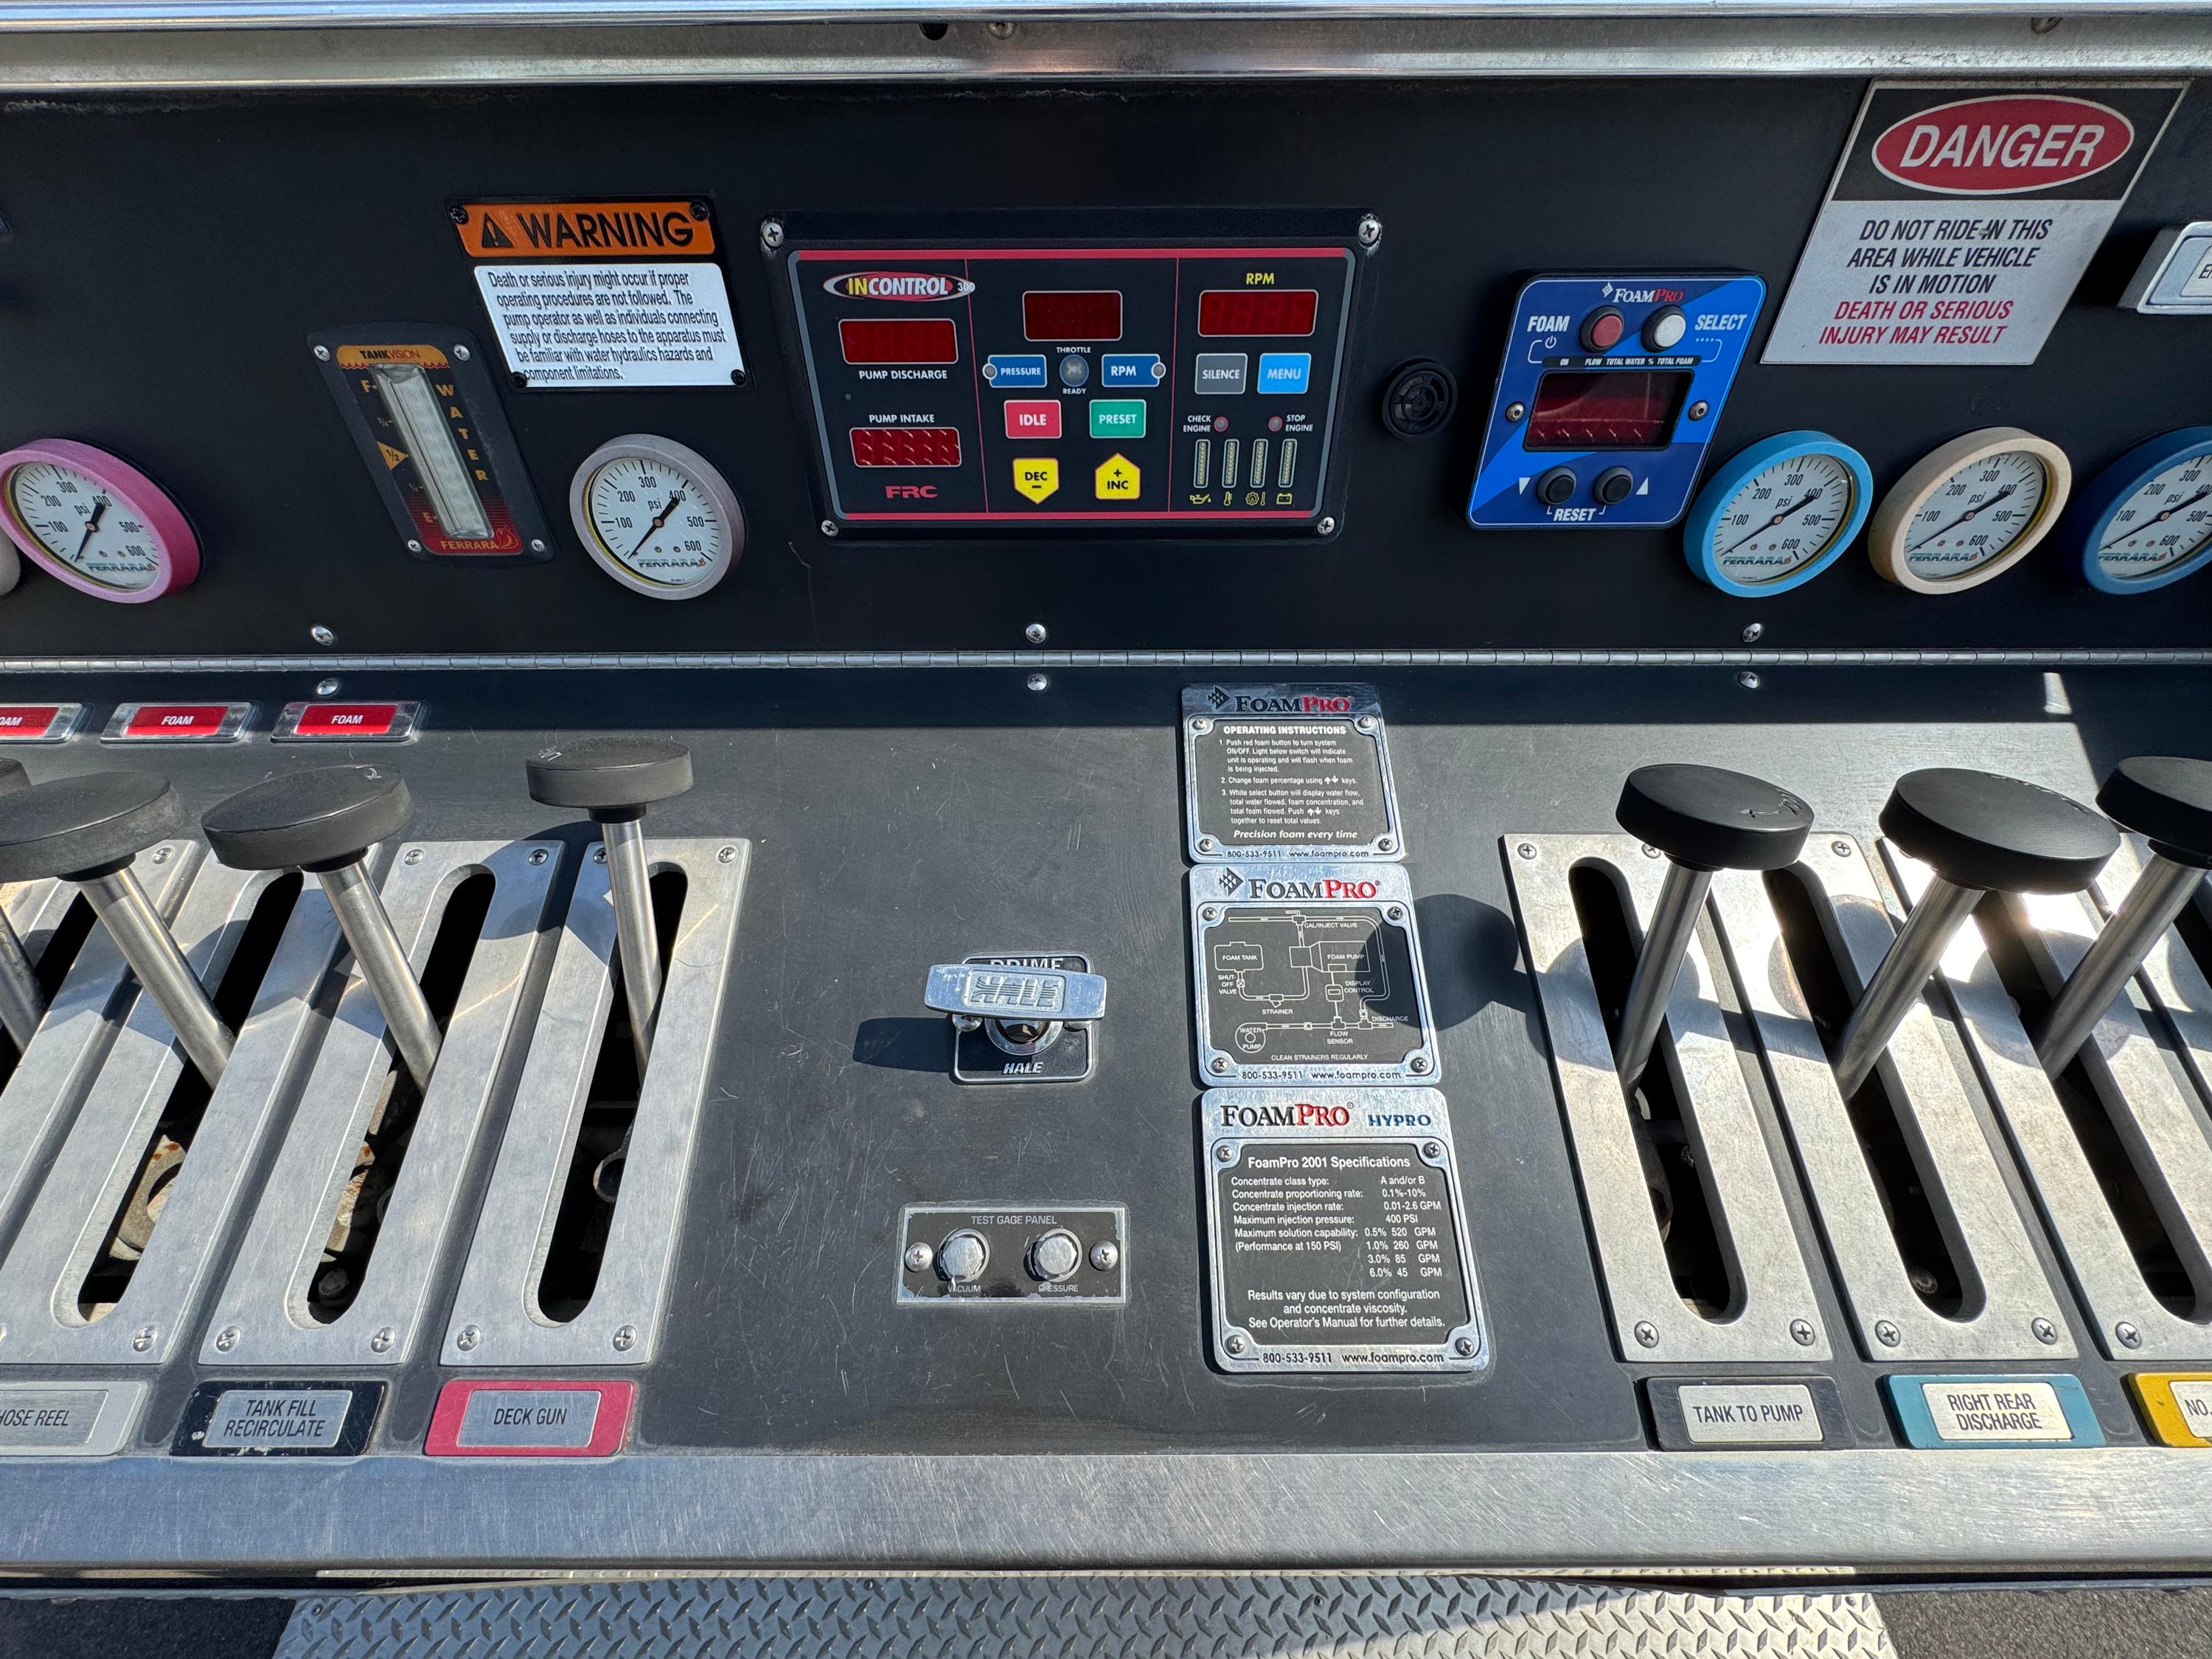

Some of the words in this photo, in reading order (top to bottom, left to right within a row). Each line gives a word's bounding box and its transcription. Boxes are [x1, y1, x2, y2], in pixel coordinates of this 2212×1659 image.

[1899, 124, 2106, 168] DANGER
[518, 212, 694, 248] WARNING
[1859, 219, 1889, 240] DO
[1892, 219, 1935, 240] NOT
[1933, 219, 1983, 240] RIDE
[1980, 219, 2007, 240] IN
[2007, 219, 2053, 240] THIS
[1846, 248, 1896, 268] AREA
[1902, 248, 1962, 268] WHILE
[1963, 247, 2041, 268] VEHICLE
[488, 271, 518, 288] Death
[520, 275, 529, 287] or
[532, 272, 566, 287] serious
[567, 271, 591, 291] injury
[594, 271, 622, 291] might
[622, 274, 647, 286] occur
[648, 271, 658, 286] if
[658, 273, 689, 291] proper
[1246, 273, 1275, 285] RPM
[1869, 274, 1888, 293] IS
[1892, 274, 1915, 293] IN
[1918, 274, 1997, 293] MOTION
[848, 277, 949, 296] INCONTROL
[957, 282, 975, 292] 300
[497, 291, 542, 310] operating
[543, 291, 594, 309] procedures
[596, 293, 611, 305] are
[612, 291, 627, 305] not
[628, 290, 672, 305] followed.
[674, 290, 693, 305] The
[1834, 301, 1896, 320] DEATH
[1902, 301, 1926, 319] OR
[1930, 301, 2014, 319] SERIOUS
[1528, 316, 1571, 333] FOAM
[1695, 314, 1747, 330] SELECT
[1819, 326, 1888, 344] INJURY
[1890, 326, 1932, 344] MAY
[1933, 326, 2008, 344] RESULT
[1559, 358, 1569, 366] ON
[1585, 358, 1602, 366] FLOW
[1606, 358, 1624, 366] TOTAL
[1625, 358, 1645, 366] WATER
[1647, 358, 1654, 366] %
[1657, 358, 1674, 366] TOTAL
[524, 368, 574, 383] component
[574, 366, 624, 380] limitations.
[859, 370, 888, 380] PUMP
[891, 370, 948, 380] DISCHARGE
[1001, 367, 1041, 376] PRESSURE
[1110, 366, 1137, 377] RPM
[1202, 369, 1240, 380] SILENCE
[1267, 369, 1301, 380] MENU
[869, 414, 898, 423] PUMP
[900, 414, 935, 423] INTAKE
[1019, 414, 1047, 425] IDLE
[1099, 414, 1137, 425] PRESET
[1187, 415, 1211, 423] CHECK
[1287, 414, 1306, 422] STOP
[1285, 424, 1313, 432] ENGINE
[639, 476, 657, 488] 300
[1024, 471, 1048, 481] DEC
[1784, 474, 1804, 486] 300
[1107, 481, 1129, 490] INC
[617, 490, 636, 502] 200
[886, 485, 938, 499] FRC
[1752, 488, 1772, 500] 200
[1554, 507, 1596, 521] RESET
[1731, 514, 1749, 526] 100
[1802, 514, 1821, 526] 500
[687, 516, 704, 527] 500
[440, 540, 498, 549] FERRARA
[684, 540, 701, 552] 600
[1781, 538, 1800, 549] 600
[161, 715, 194, 725] FOAM
[331, 714, 364, 724] FOAM
[1223, 726, 1276, 734] OPERATING
[1278, 726, 1347, 734] INSTRUCTIONS
[1234, 830, 1277, 838] Precision
[1279, 830, 1305, 838] foam
[1307, 831, 1334, 841] every
[1336, 830, 1357, 838] time
[1227, 850, 1281, 858] 800-533-9511
[1289, 850, 1369, 860] www.foampro.com
[1002, 1062, 1043, 1074] HALE
[1242, 1071, 1303, 1079] 800-533-9511
[1312, 1071, 1401, 1081] www.foampro.com
[1368, 1114, 1432, 1127] HYPRO
[1248, 1156, 1299, 1169] FoamPro
[1301, 1156, 1328, 1169] 2001
[1330, 1155, 1411, 1170] Specifications
[1231, 1177, 1282, 1186] Concentrate
[1284, 1177, 1307, 1186] class
[1308, 1178, 1329, 1188] type:
[1380, 1176, 1388, 1185] A
[1389, 1175, 1416, 1185] and/or
[1418, 1176, 1425, 1185] B
[971, 1216, 995, 1225] TEST
[996, 1215, 1023, 1225] GAGE
[1025, 1215, 1057, 1225] PANEL
[1234, 1215, 1276, 1225] Maximum
[1277, 1215, 1314, 1225] injection
[1315, 1216, 1354, 1226] pressure:
[1385, 1214, 1402, 1224] 400
[1403, 1214, 1418, 1224] PSI
[947, 1284, 981, 1293] VACUUM
[1038, 1284, 1079, 1293] PESSURE
[1248, 1290, 1284, 1301] Results
[1285, 1292, 1306, 1302] vary
[1308, 1290, 1326, 1300] due
[1328, 1290, 1339, 1300] to
[1341, 1291, 1375, 1302] system
[1377, 1288, 1440, 1301] configuration
[1262, 1352, 1332, 1364] 800-533-9511
[1341, 1352, 1444, 1366] www.foampro.com
[246, 1400, 288, 1416] TANK
[287, 1400, 316, 1416] FILL
[1947, 1394, 1992, 1411] RIGHT
[1993, 1393, 2037, 1411] REAR
[35, 1410, 70, 1427] REEL
[493, 1408, 533, 1425] DECK
[535, 1408, 567, 1425] GUN
[1692, 1406, 1733, 1424] TANK
[1736, 1405, 1757, 1423] TO
[1760, 1405, 1804, 1423] PUMP
[1955, 1412, 2043, 1430] DISCHARGE
[223, 1419, 326, 1437] RECIRCULATE
